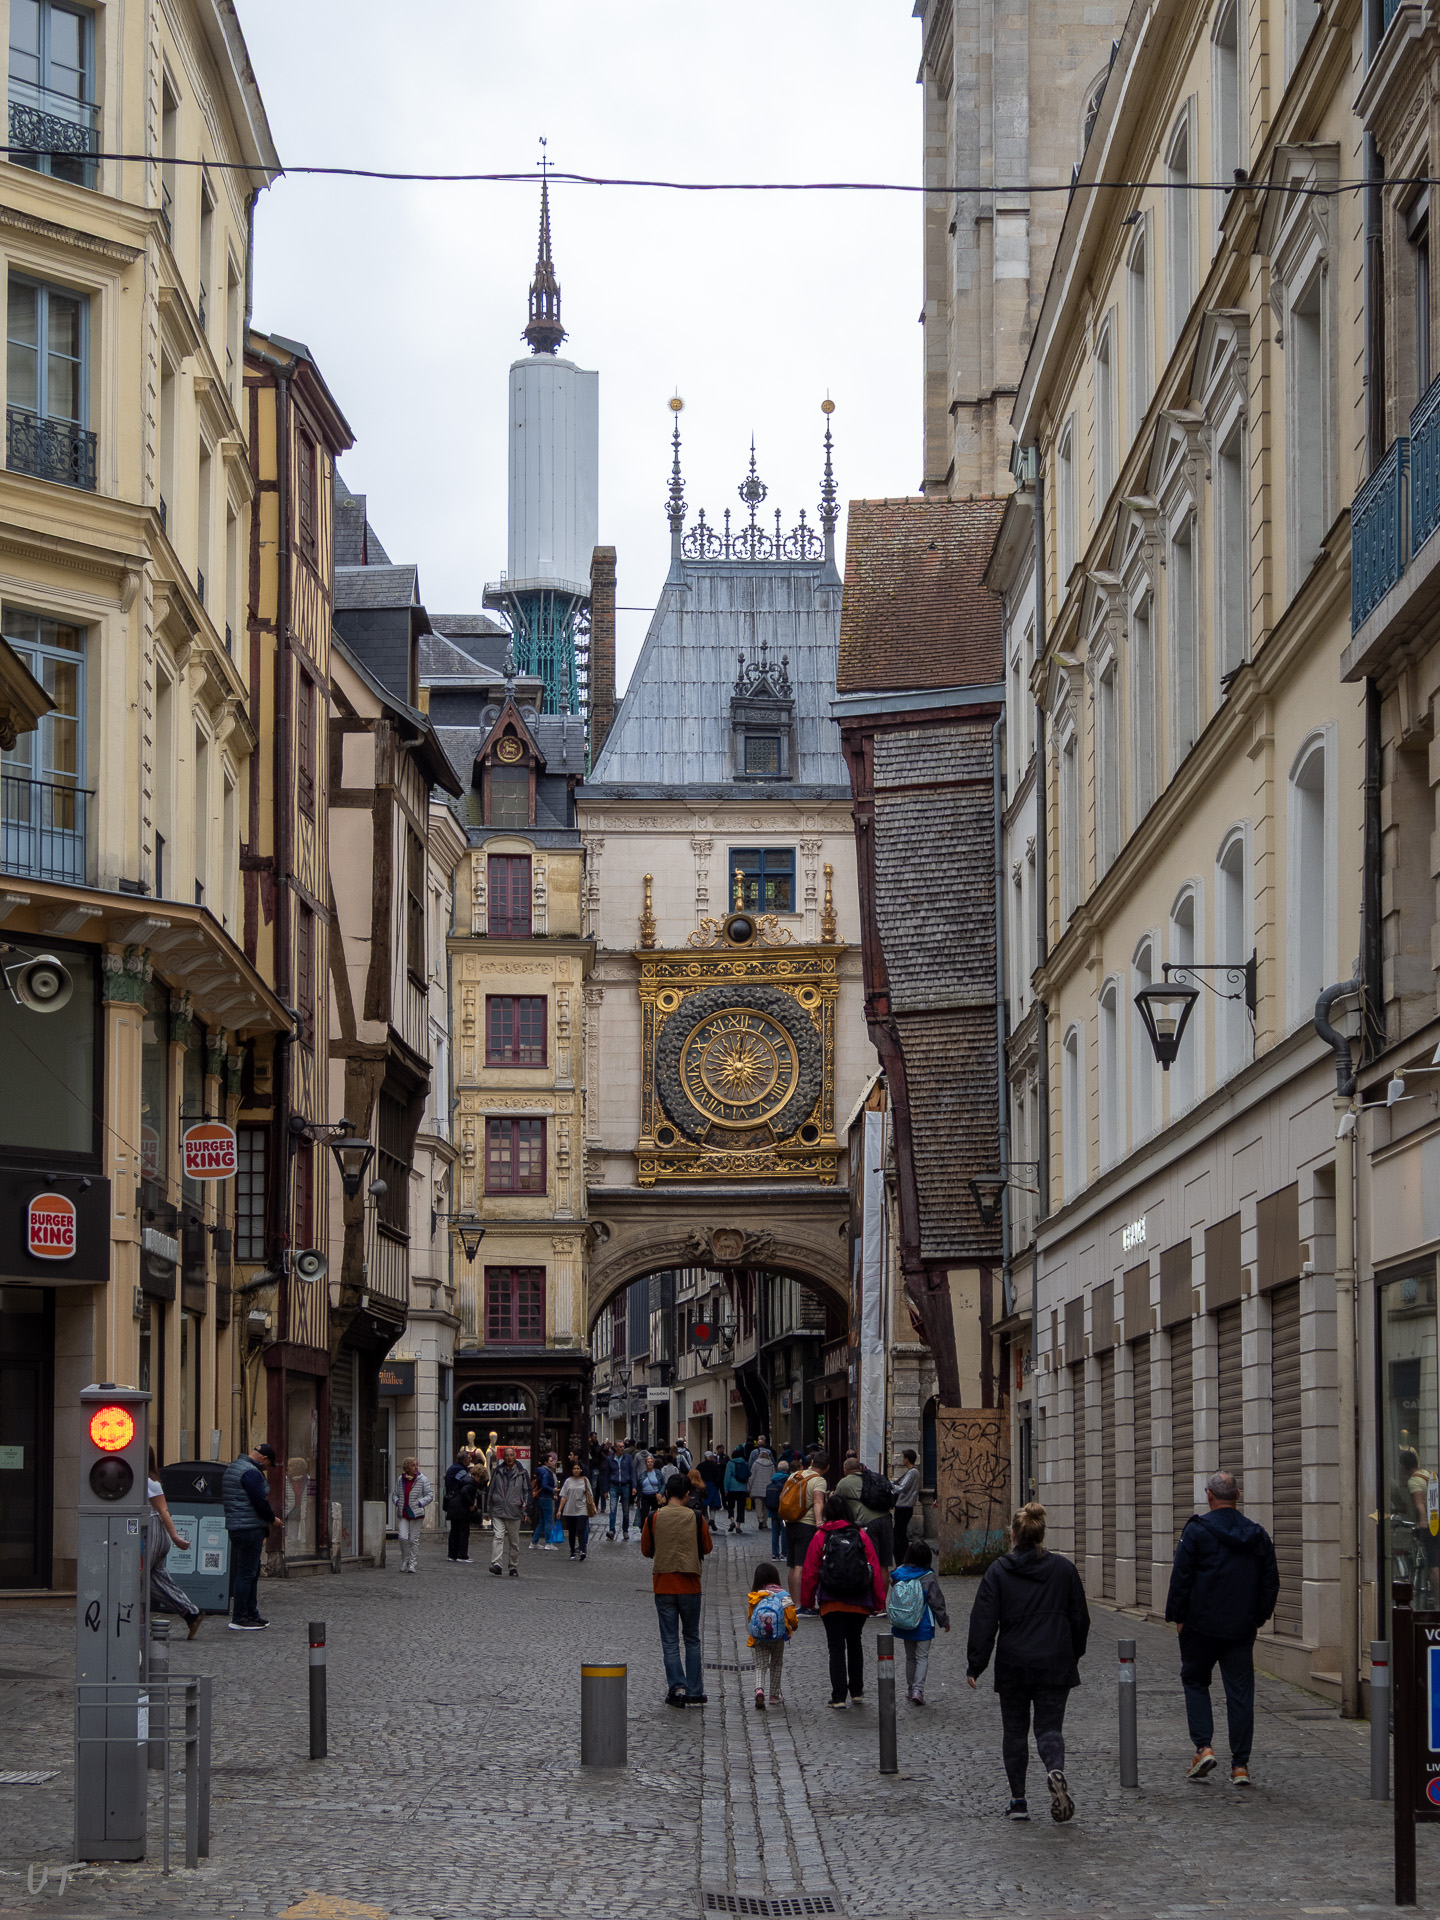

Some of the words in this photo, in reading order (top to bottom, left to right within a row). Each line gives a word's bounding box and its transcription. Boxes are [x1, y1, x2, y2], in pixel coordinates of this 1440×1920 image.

[728, 1015, 749, 1028] XII
[185, 1140, 235, 1153] BURGER
[186, 1151, 235, 1169] KING
[30, 1212, 74, 1228] BURGER
[30, 1225, 74, 1246] KING
[462, 1403, 527, 1411] CALZEDONIA
